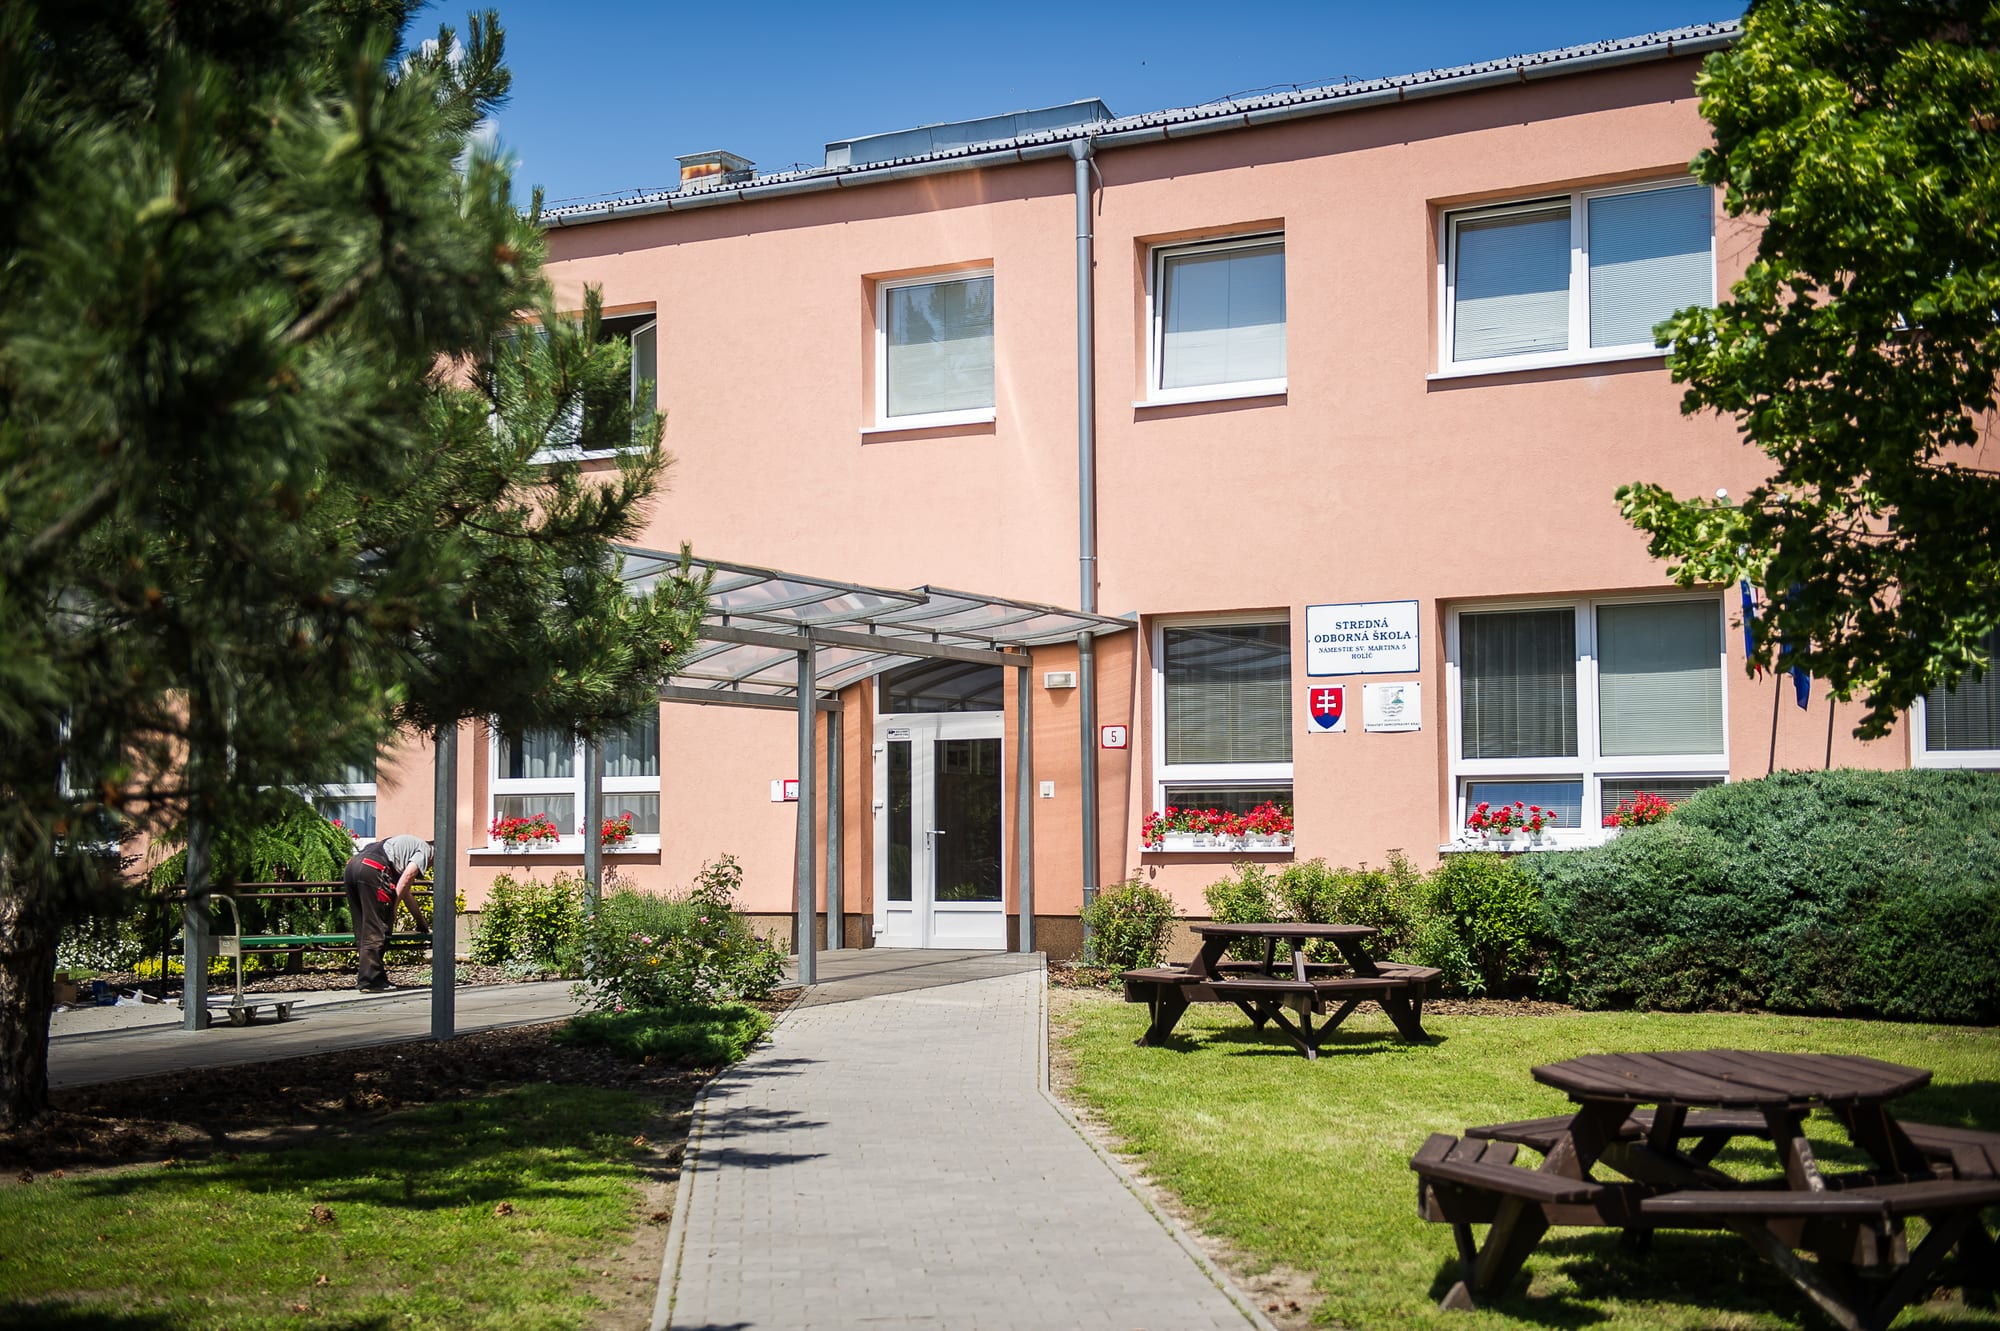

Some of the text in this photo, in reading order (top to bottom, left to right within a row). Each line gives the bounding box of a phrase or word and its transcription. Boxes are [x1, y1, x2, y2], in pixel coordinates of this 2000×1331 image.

[1335, 617, 1388, 630] STREDNÁ
[1314, 630, 1411, 643] ODBORNÁ ŠKOLA
[1368, 644, 1400, 652] MARTINA
[1111, 730, 1117, 743] 5
